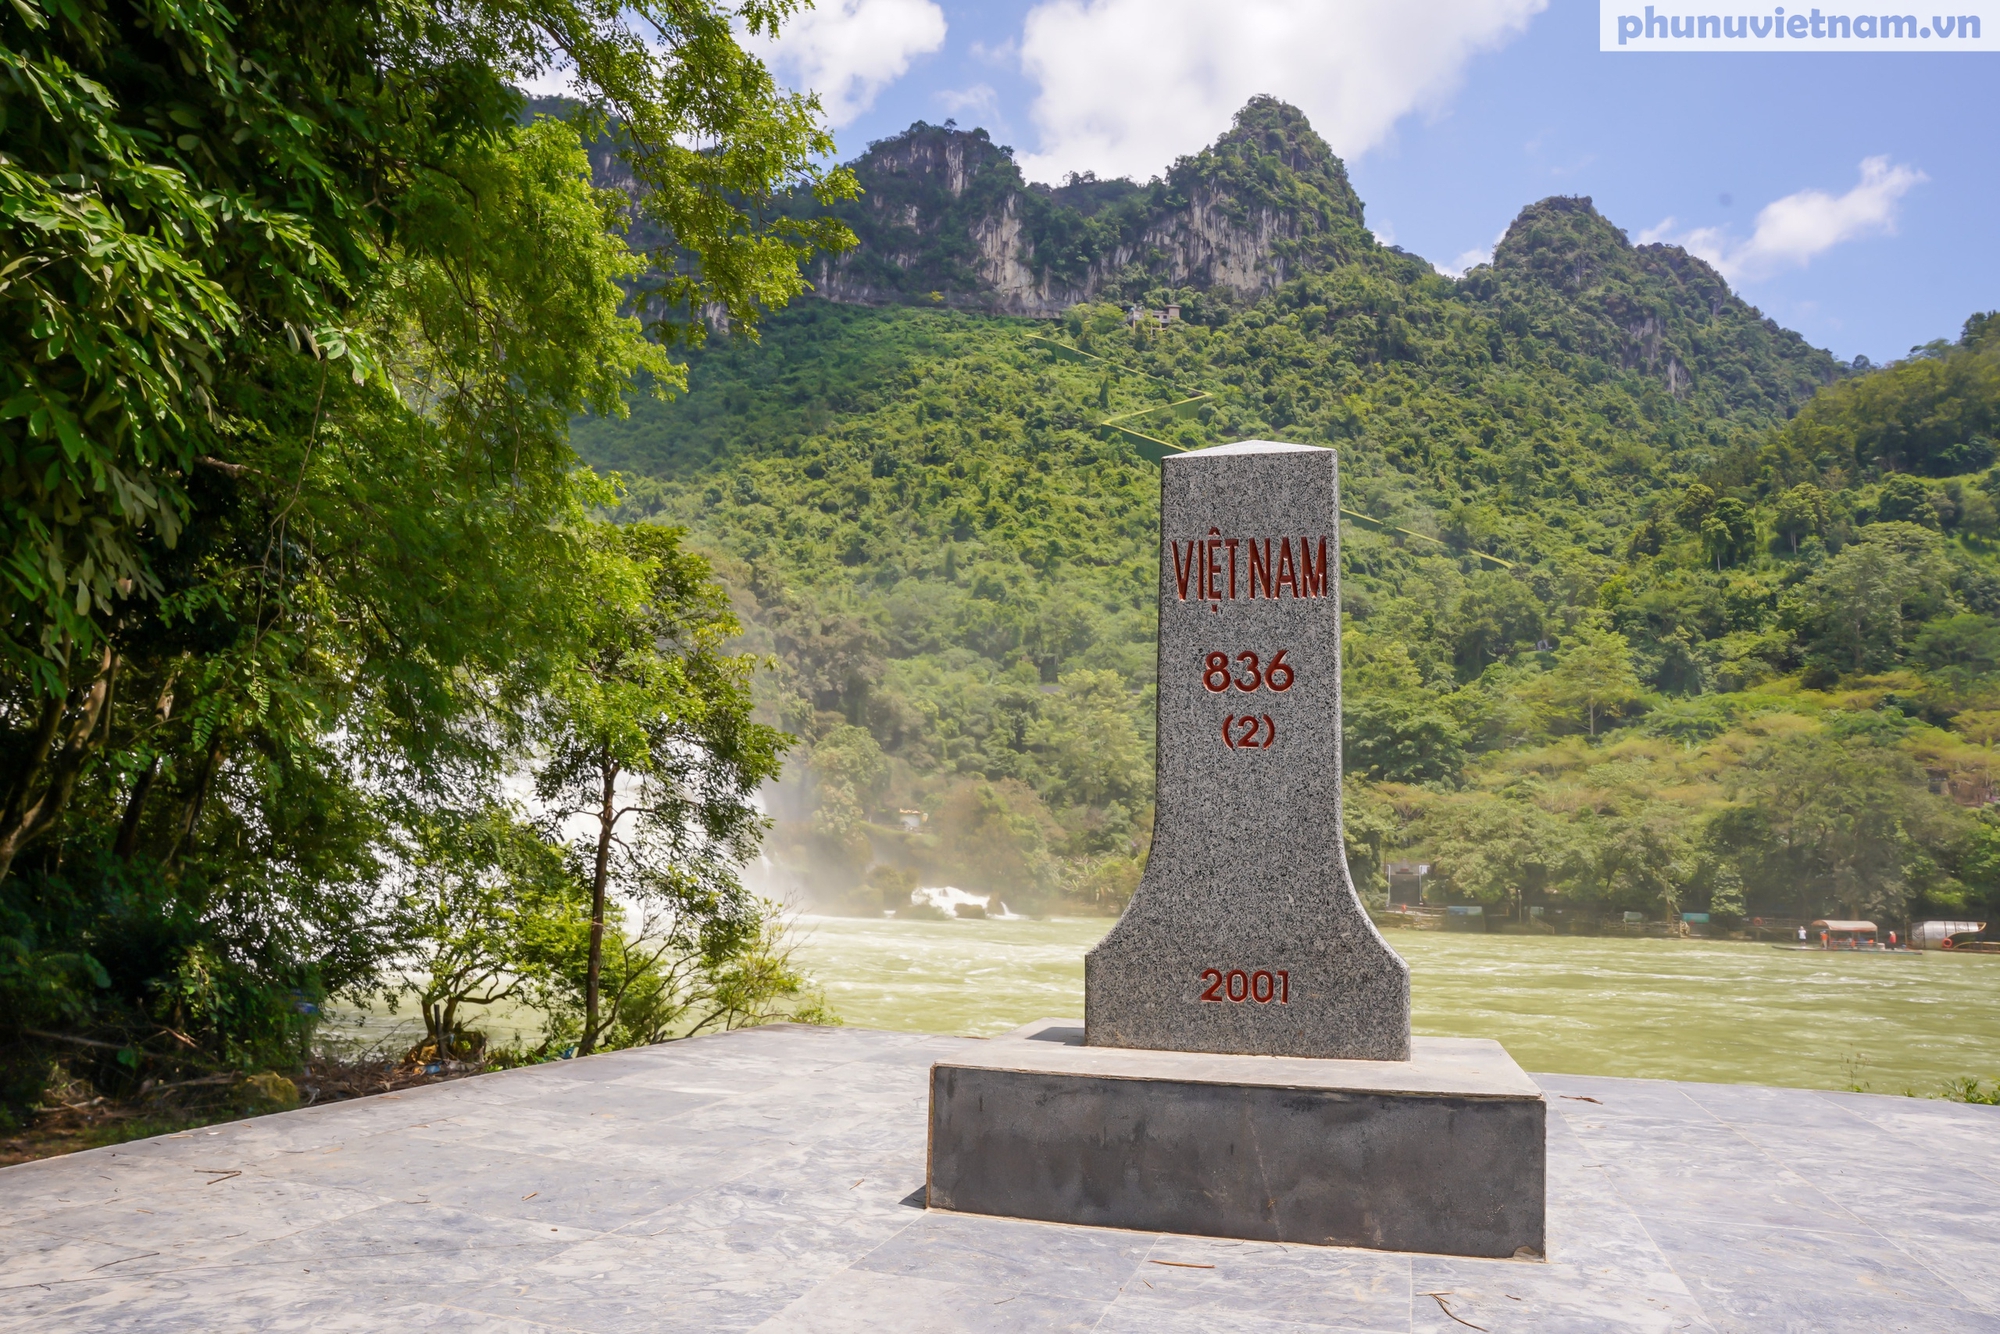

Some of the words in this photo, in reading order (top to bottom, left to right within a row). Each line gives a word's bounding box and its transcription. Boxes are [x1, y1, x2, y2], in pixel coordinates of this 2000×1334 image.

[1171, 527, 1239, 612] VIỆT
[1249, 535, 1328, 600] NAM
[1202, 650, 1294, 694] 836
[1222, 714, 1276, 750] (2)
[1201, 968, 1289, 1005] 2001
